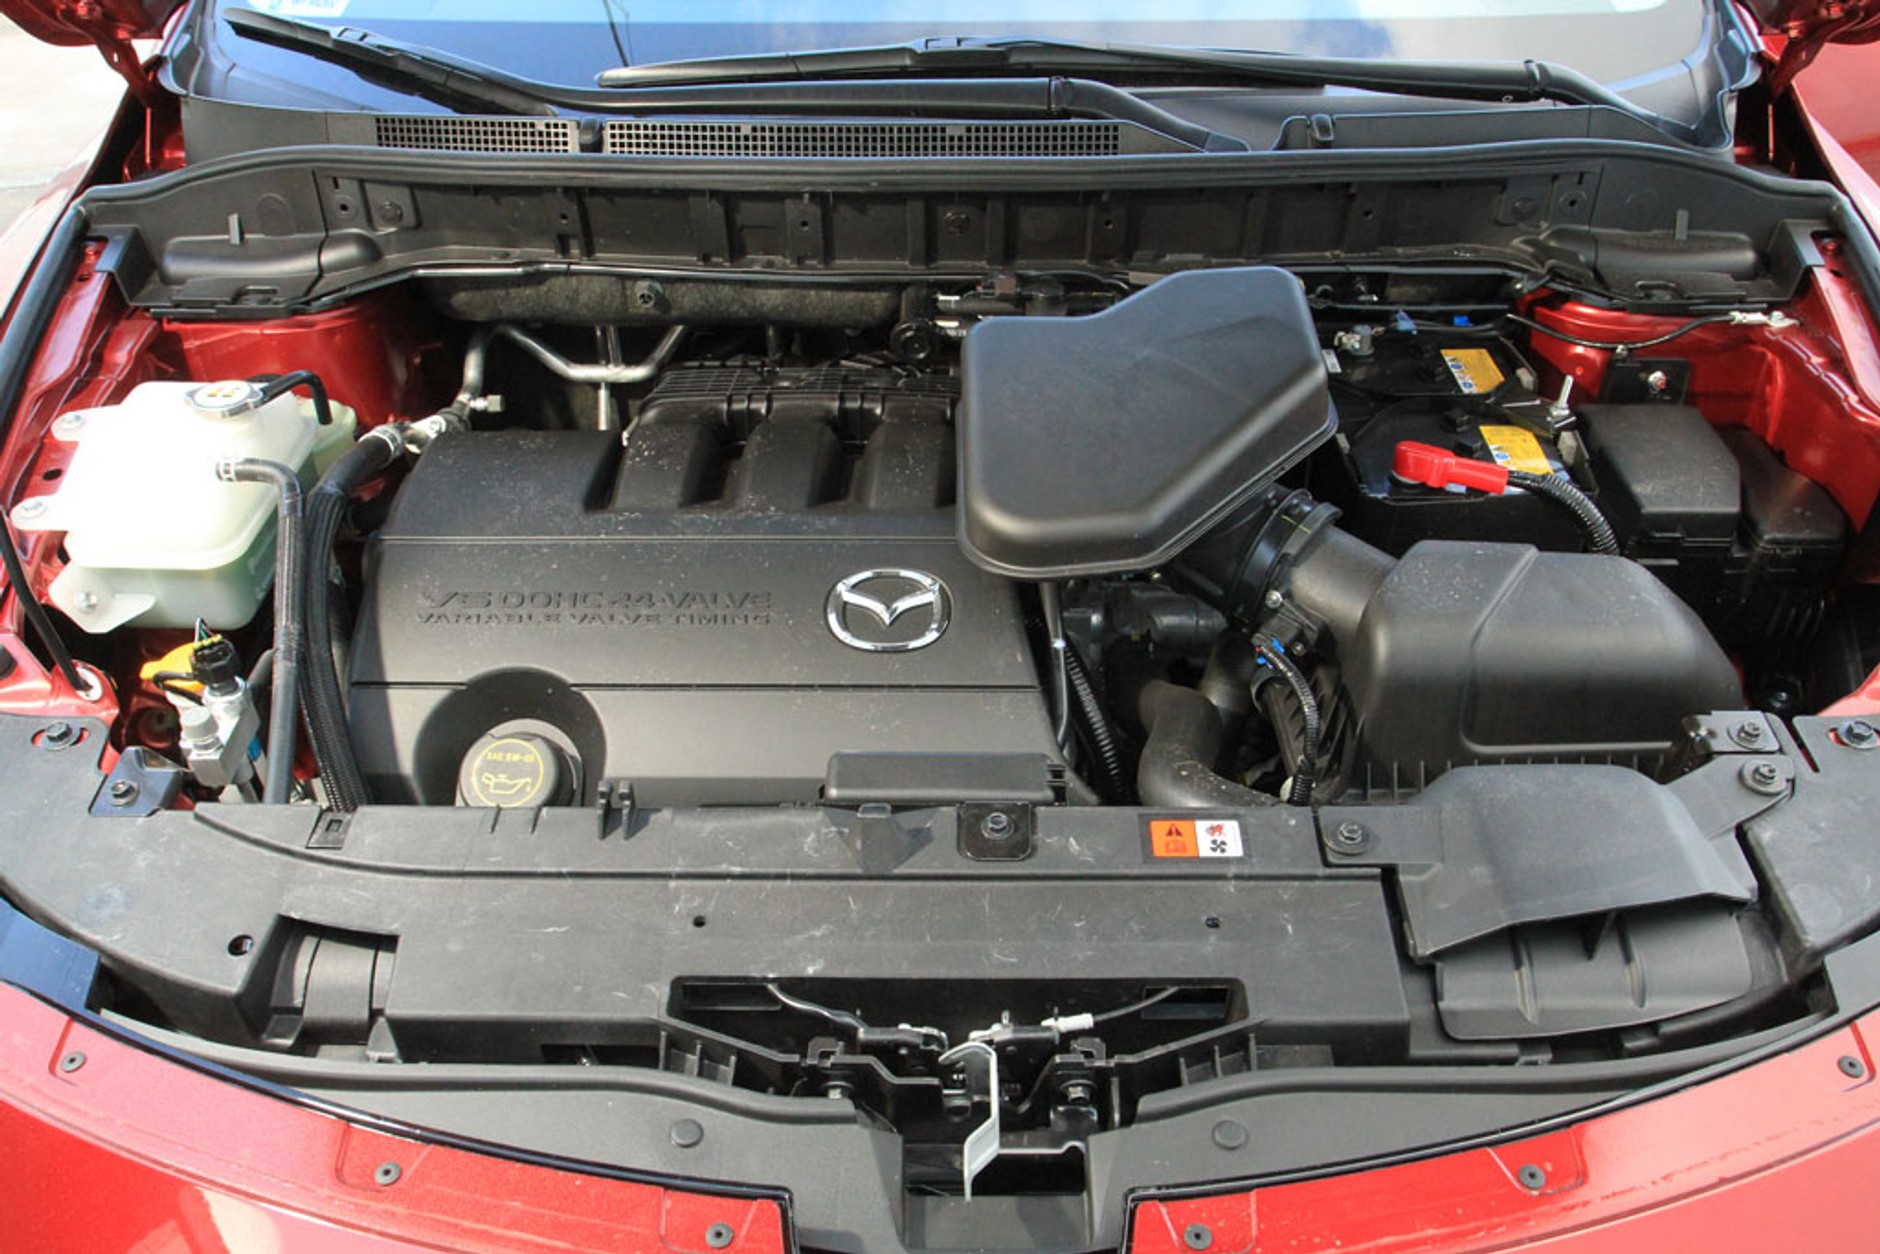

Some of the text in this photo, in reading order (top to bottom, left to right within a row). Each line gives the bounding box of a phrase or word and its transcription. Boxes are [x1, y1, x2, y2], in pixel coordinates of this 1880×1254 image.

[500, 591, 604, 609] DOHC
[416, 612, 773, 626] VARIABLE VALVE TIMING
